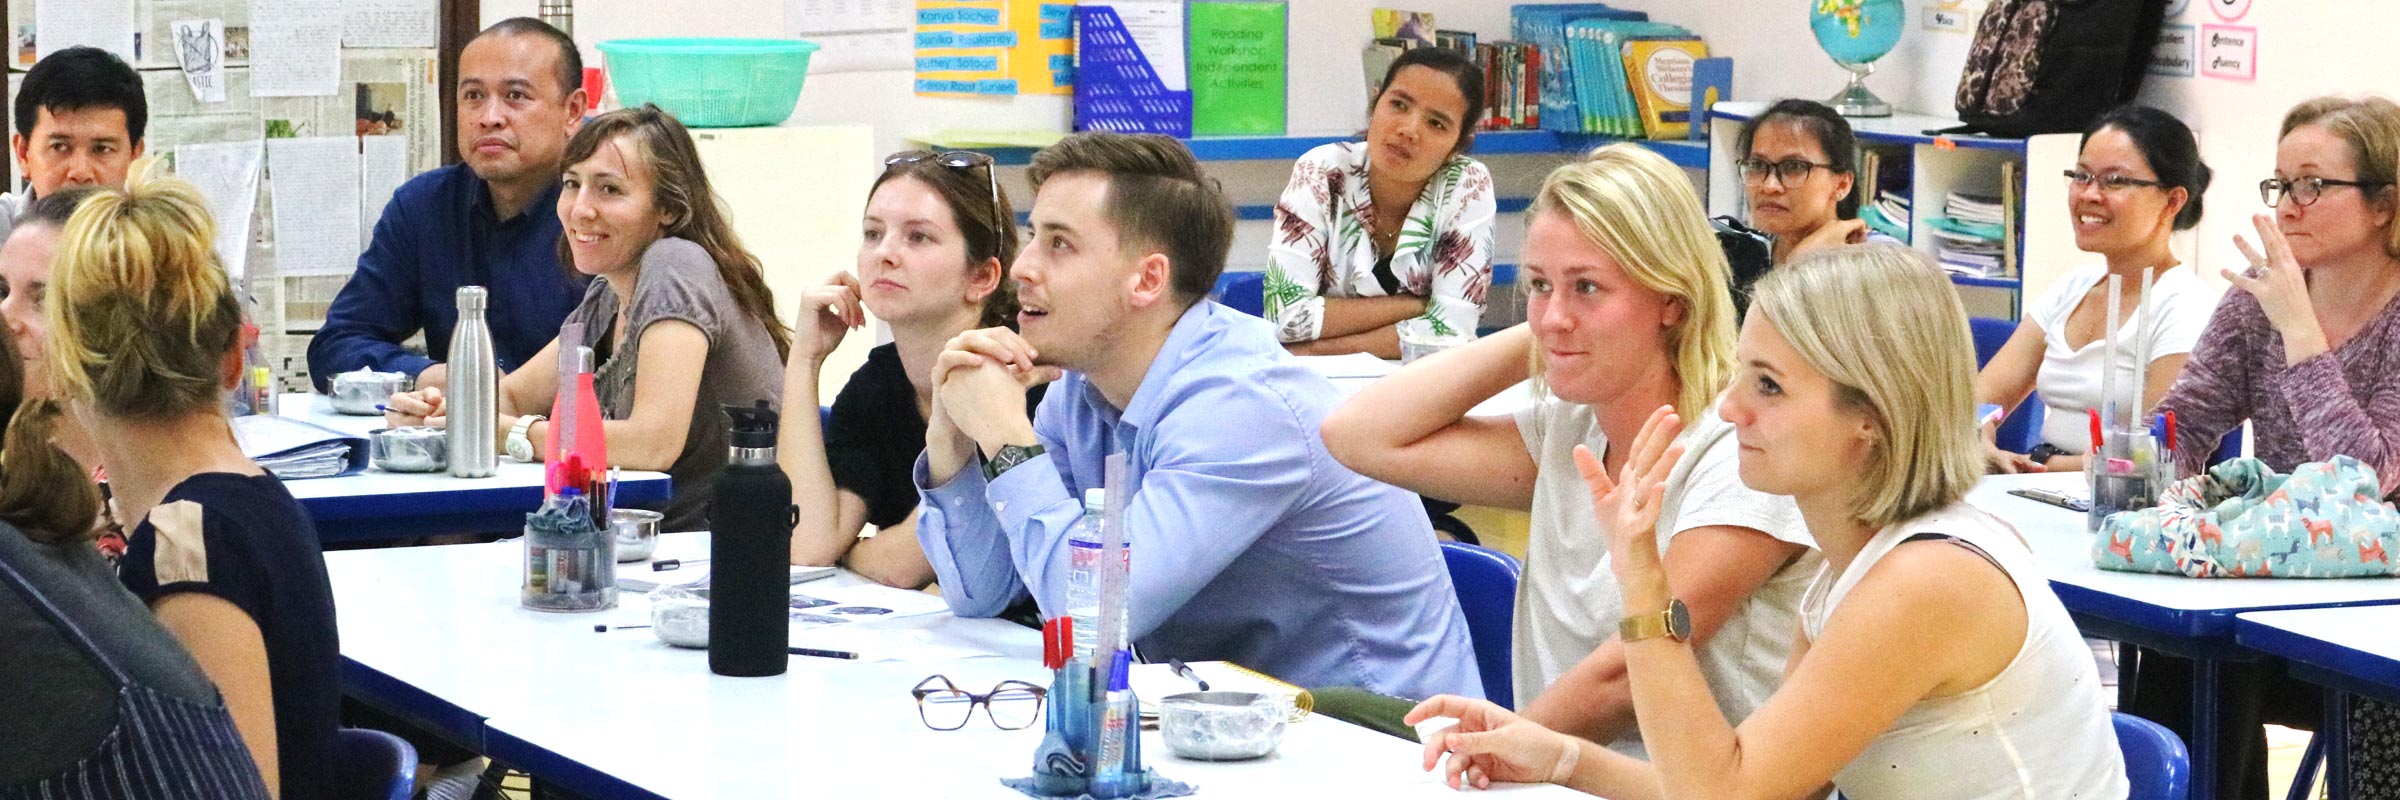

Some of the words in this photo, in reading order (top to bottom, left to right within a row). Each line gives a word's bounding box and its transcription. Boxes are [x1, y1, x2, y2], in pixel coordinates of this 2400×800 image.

[1210, 28, 1264, 41] Reading
[2211, 33, 2245, 47] Sentence
[1196, 62, 1277, 74] Independent
[1209, 79, 1264, 89] Activities
